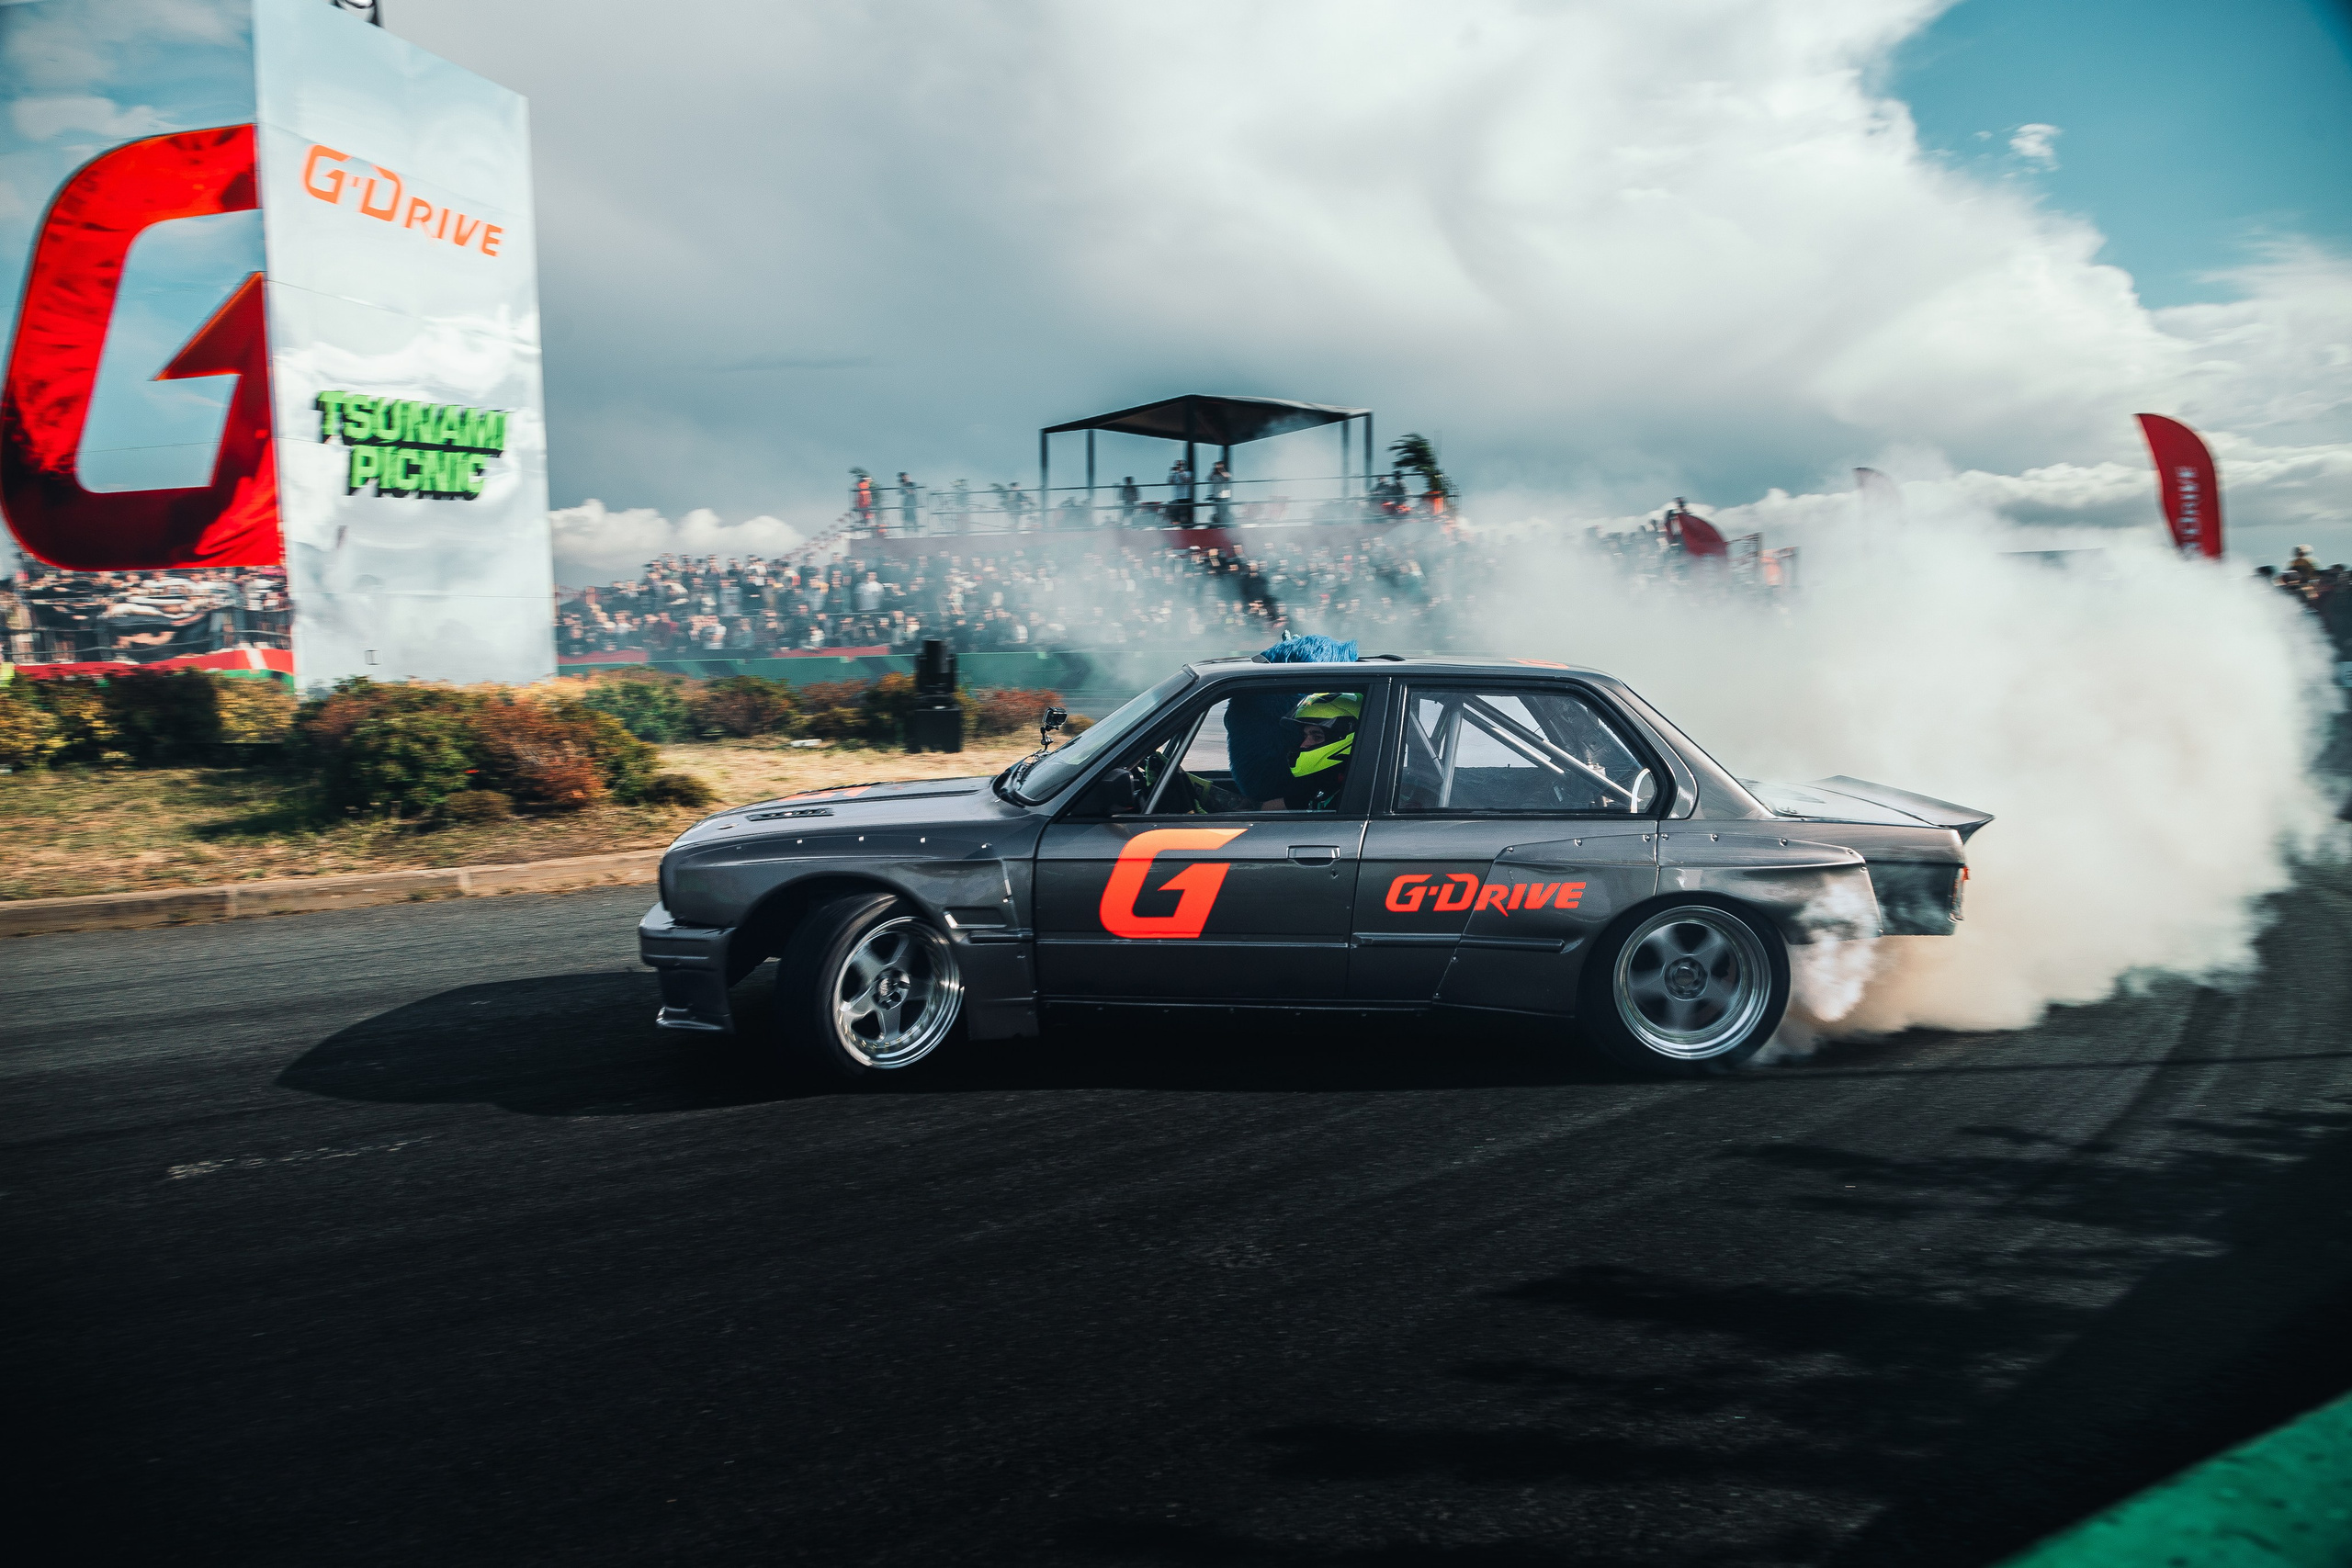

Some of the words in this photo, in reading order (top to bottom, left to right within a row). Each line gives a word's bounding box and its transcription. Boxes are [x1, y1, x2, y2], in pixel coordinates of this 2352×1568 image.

[314, 389, 511, 456] TSUNAMI
[345, 444, 489, 501] PICNIC
[1100, 829, 1248, 939] G
